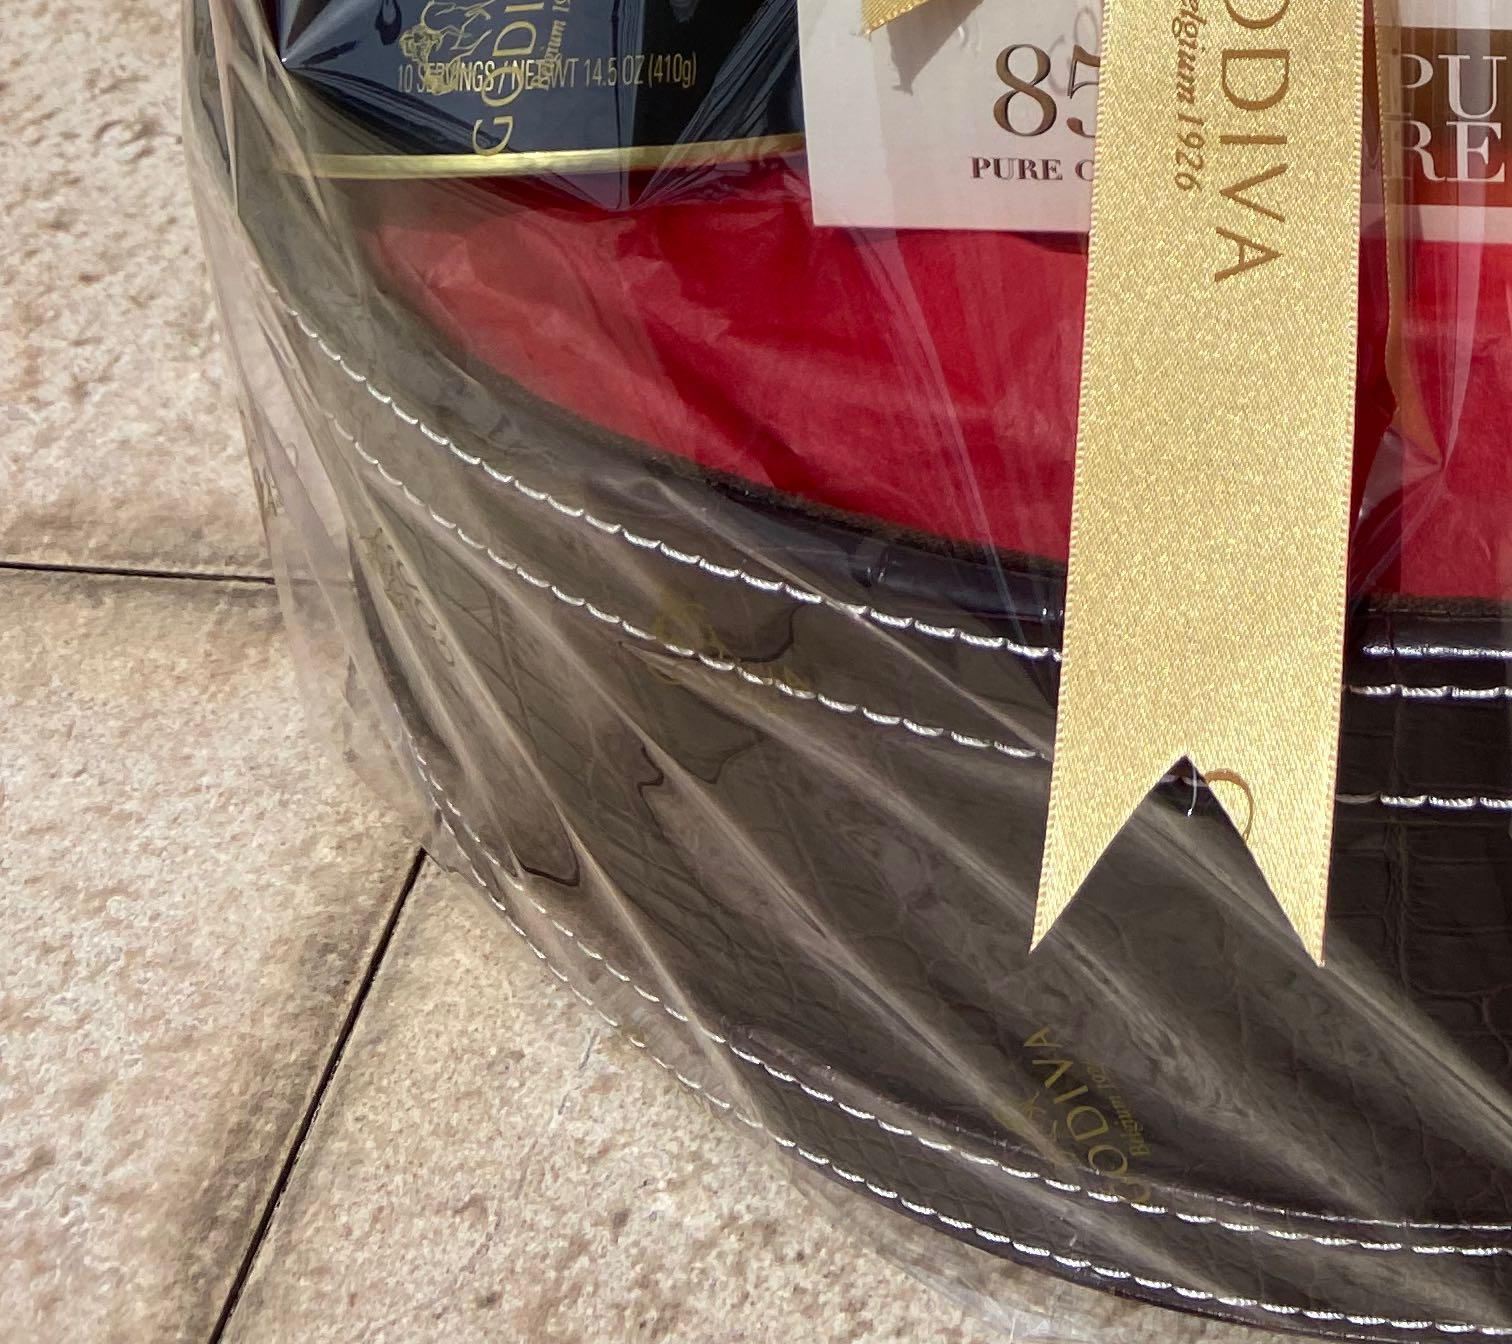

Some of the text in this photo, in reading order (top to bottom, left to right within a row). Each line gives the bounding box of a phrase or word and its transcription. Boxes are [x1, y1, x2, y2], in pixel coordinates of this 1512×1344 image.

[584, 55, 617, 88] 14.5
[622, 53, 644, 86] OZ
[650, 51, 697, 90] (410g)
[1174, 102, 1206, 193] 1926
[969, 155, 1064, 181] PURE
